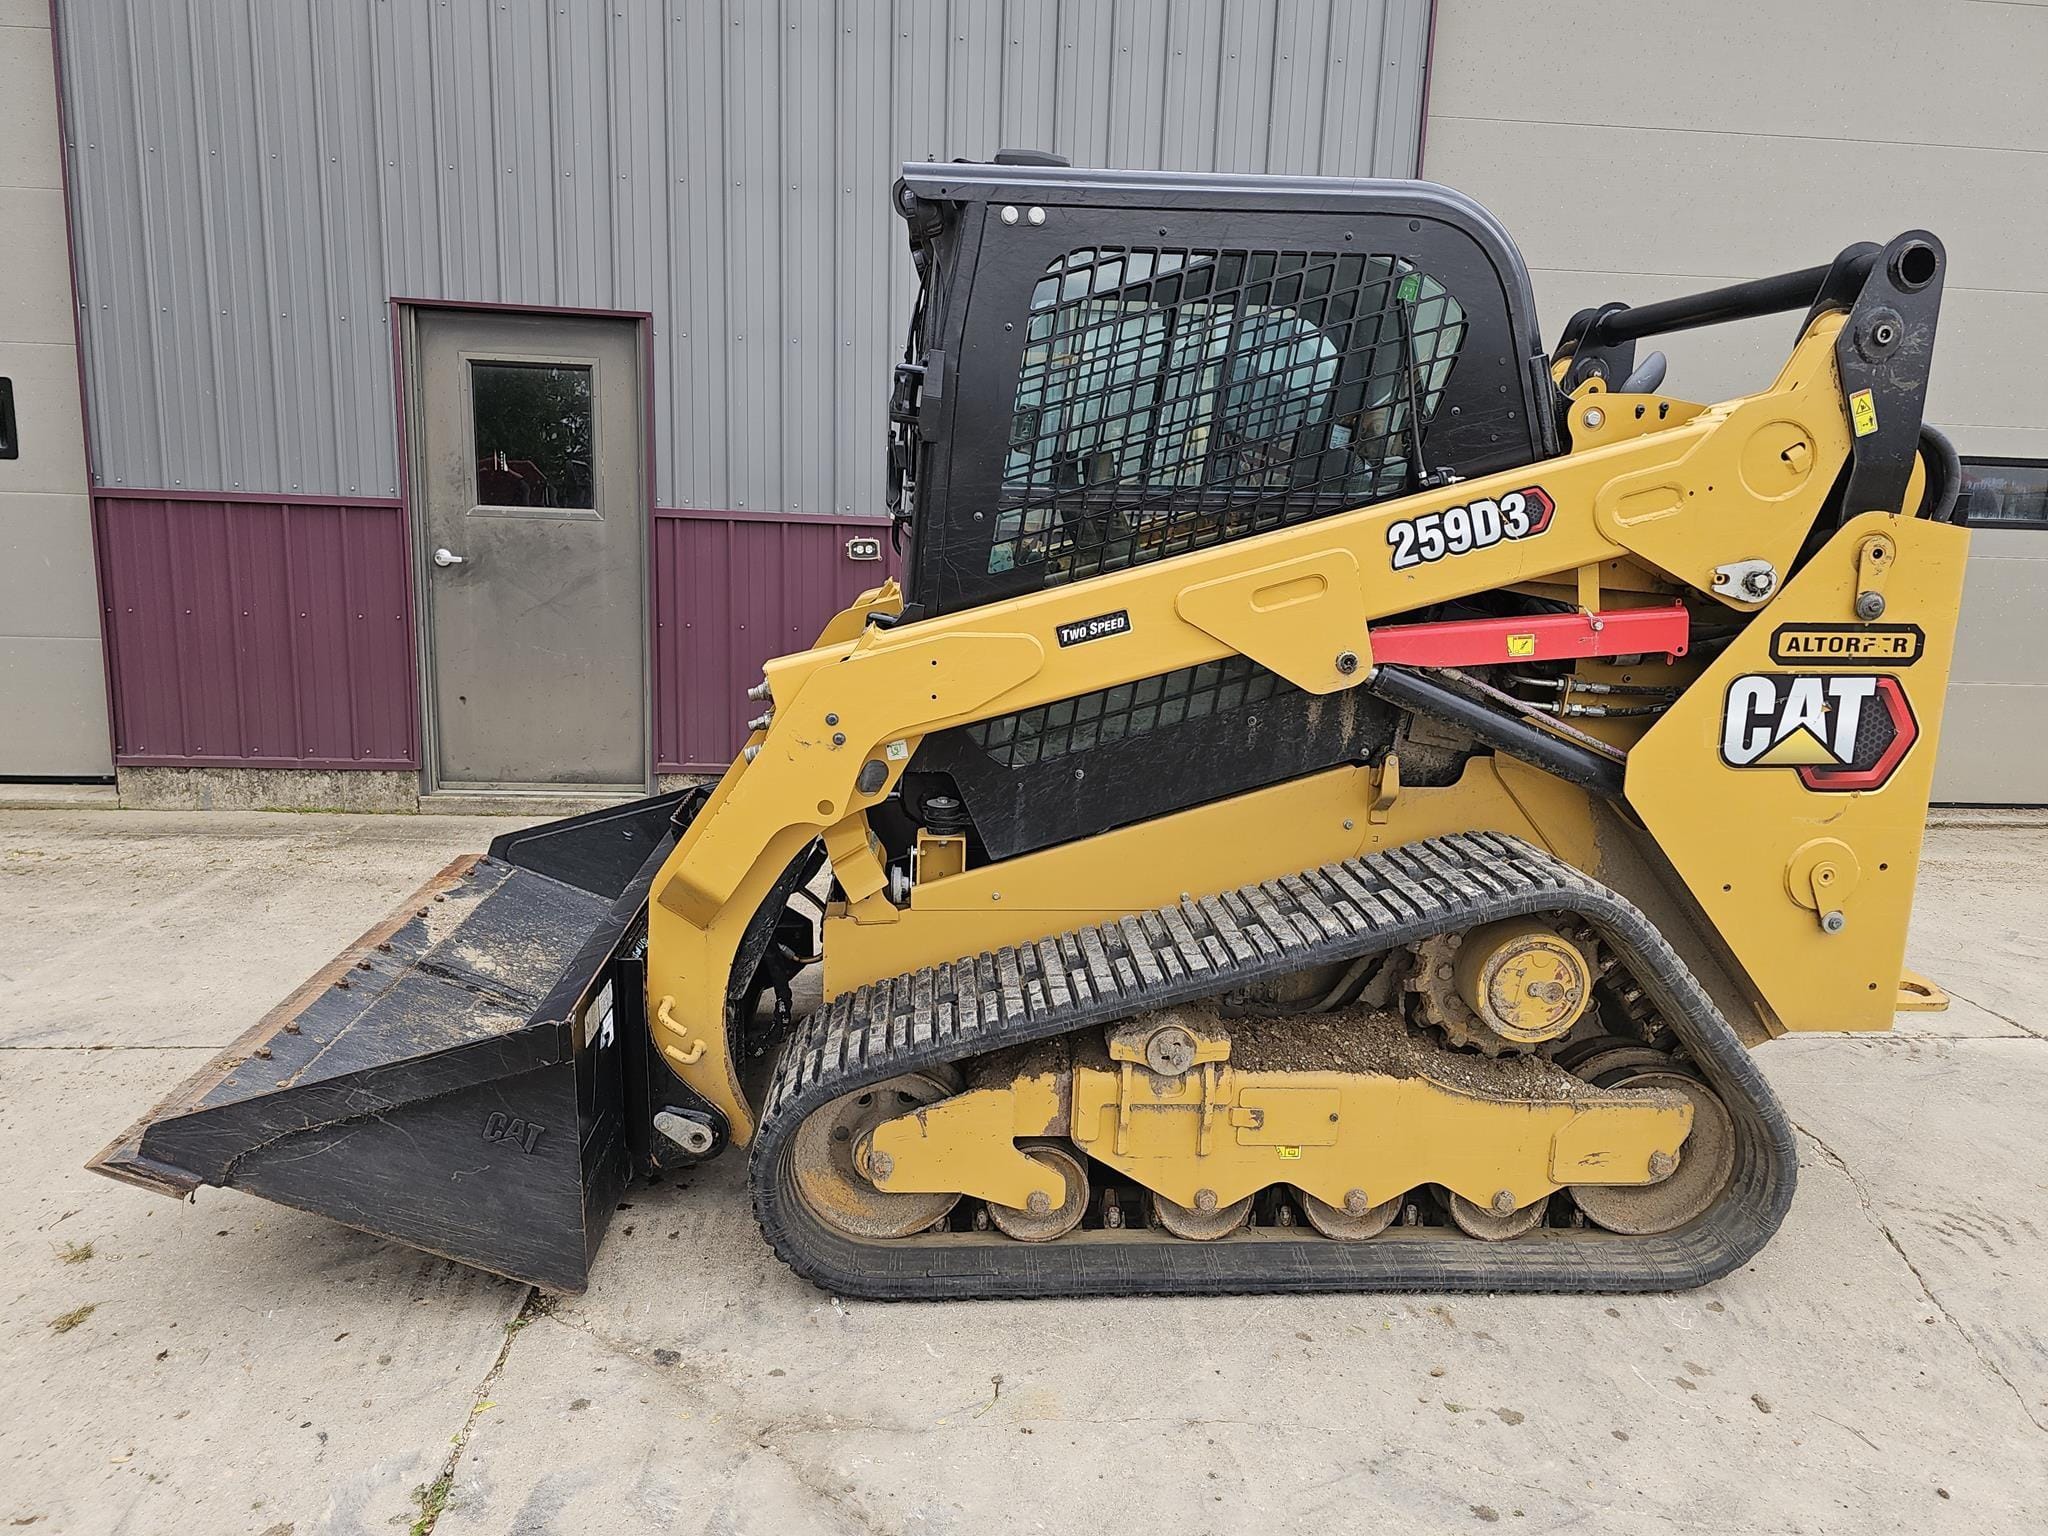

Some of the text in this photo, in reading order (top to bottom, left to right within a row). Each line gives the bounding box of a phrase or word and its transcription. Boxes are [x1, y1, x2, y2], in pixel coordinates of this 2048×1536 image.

[1388, 493, 1530, 568] 259D3
[1723, 675, 1877, 765] CAT
[482, 1111, 545, 1155] CAT
